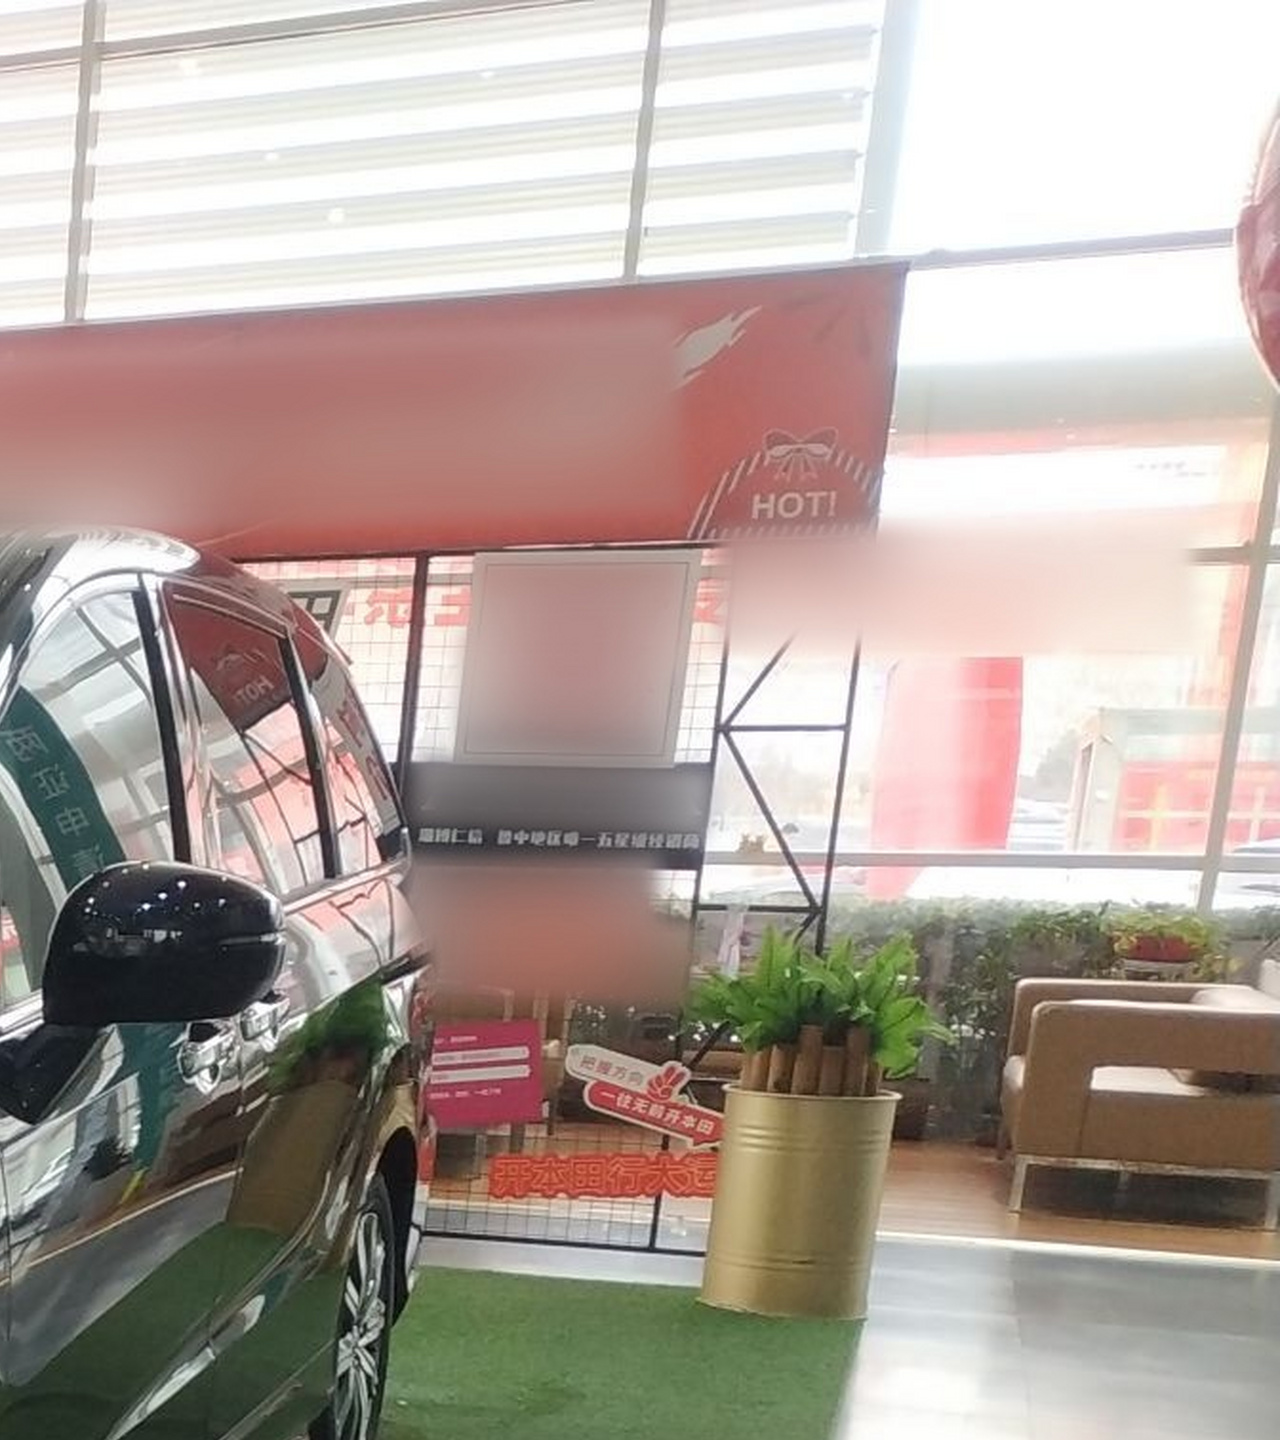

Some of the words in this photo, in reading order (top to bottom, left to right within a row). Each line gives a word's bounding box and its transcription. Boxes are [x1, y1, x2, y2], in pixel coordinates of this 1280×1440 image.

[751, 490, 838, 520] HOT!
[600, 1091, 716, 1135] 一往无前开本田
